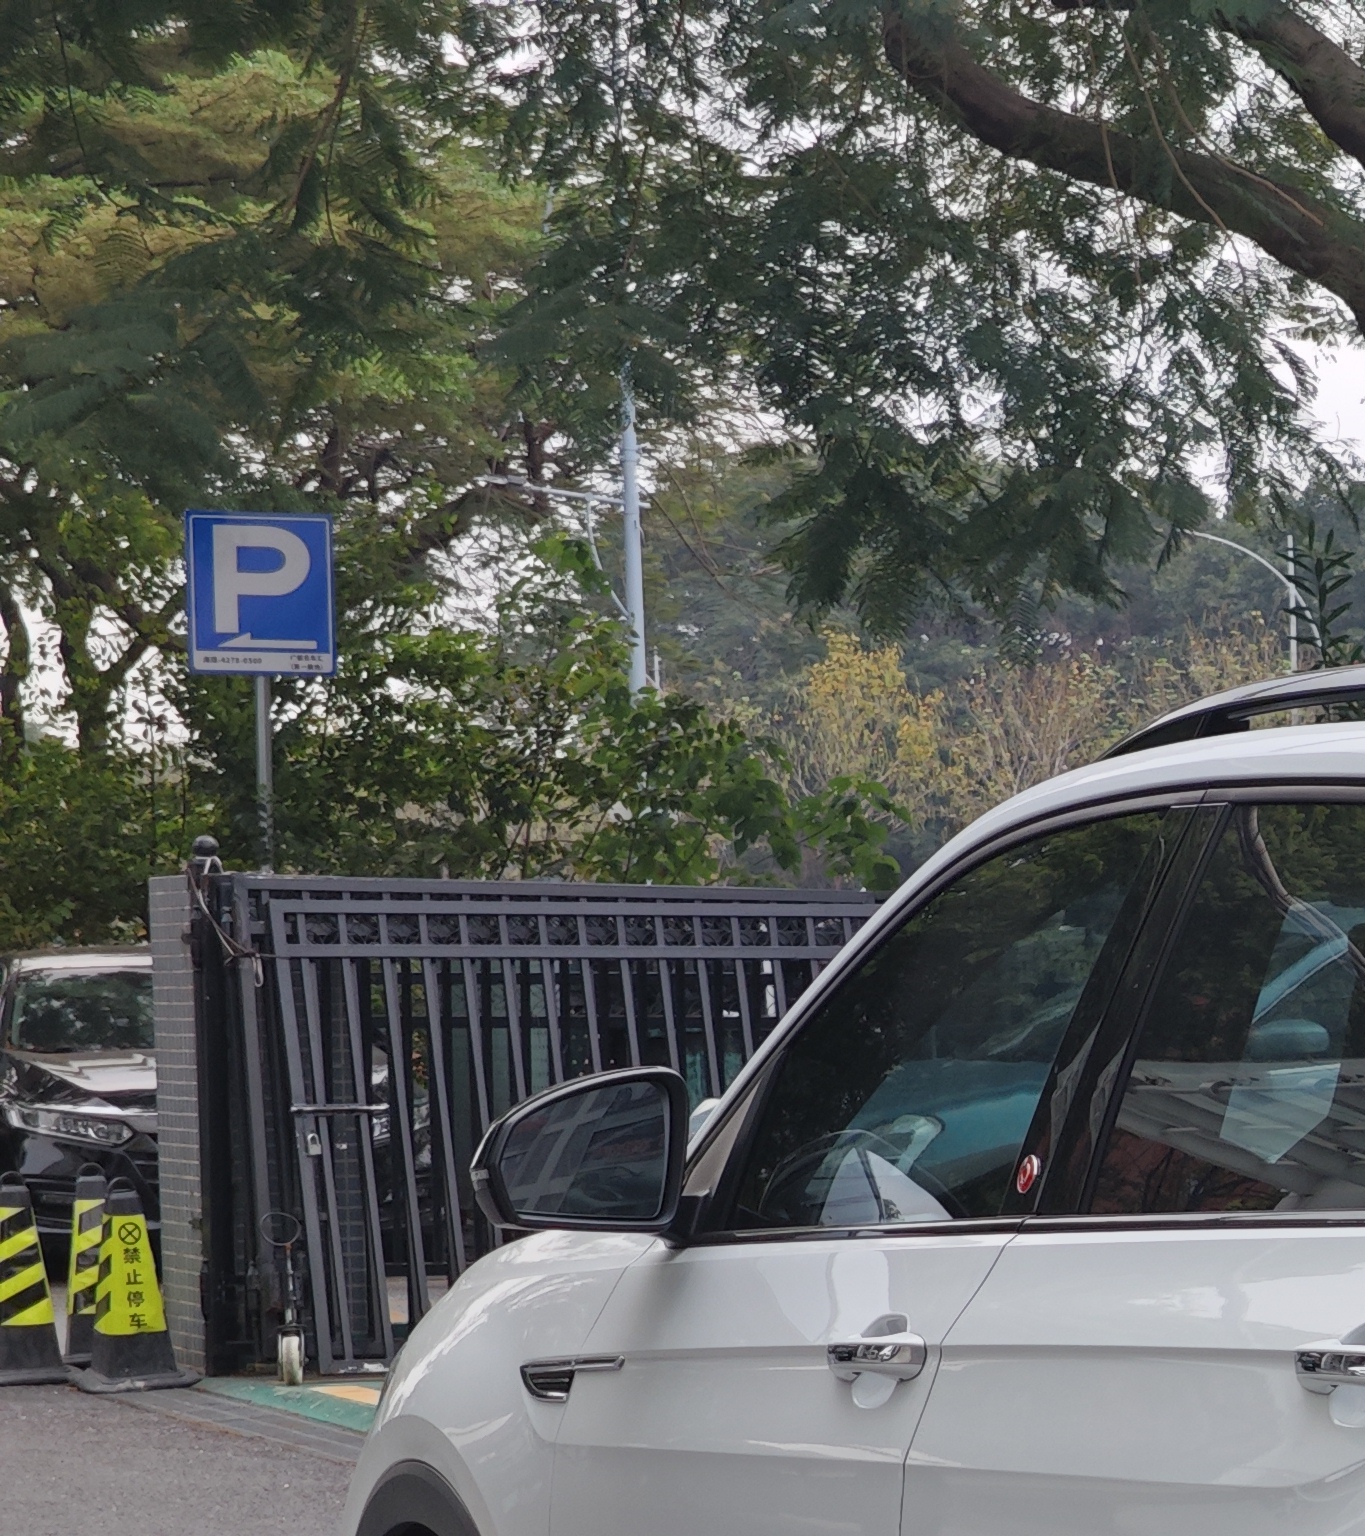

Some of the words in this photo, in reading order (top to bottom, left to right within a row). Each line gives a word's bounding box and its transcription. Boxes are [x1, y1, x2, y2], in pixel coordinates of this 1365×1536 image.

[212, 524, 310, 633] P
[123, 1246, 148, 1329] 禁止停车
